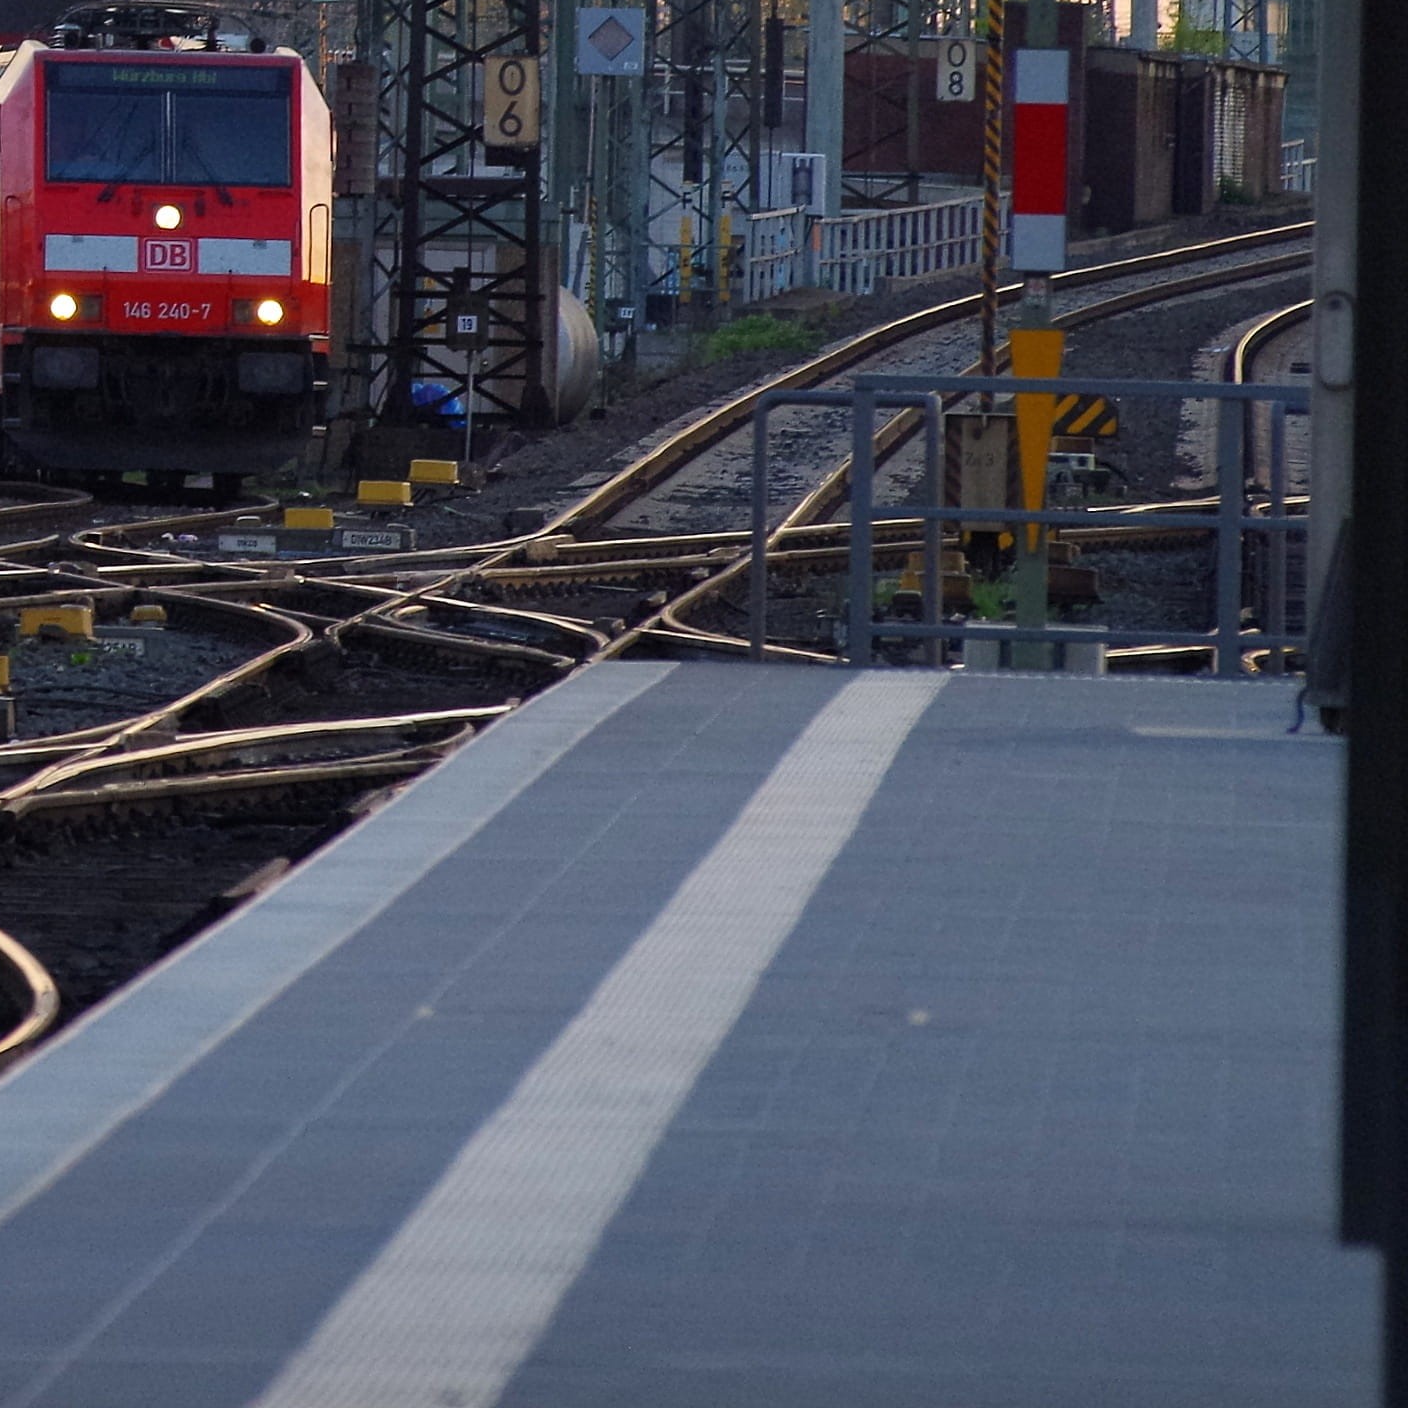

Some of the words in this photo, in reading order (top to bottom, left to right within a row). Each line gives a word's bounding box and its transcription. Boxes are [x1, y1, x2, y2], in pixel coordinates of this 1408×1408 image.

[148, 242, 187, 267] DB
[123, 301, 152, 319] 146
[157, 302, 212, 320] 240-7
